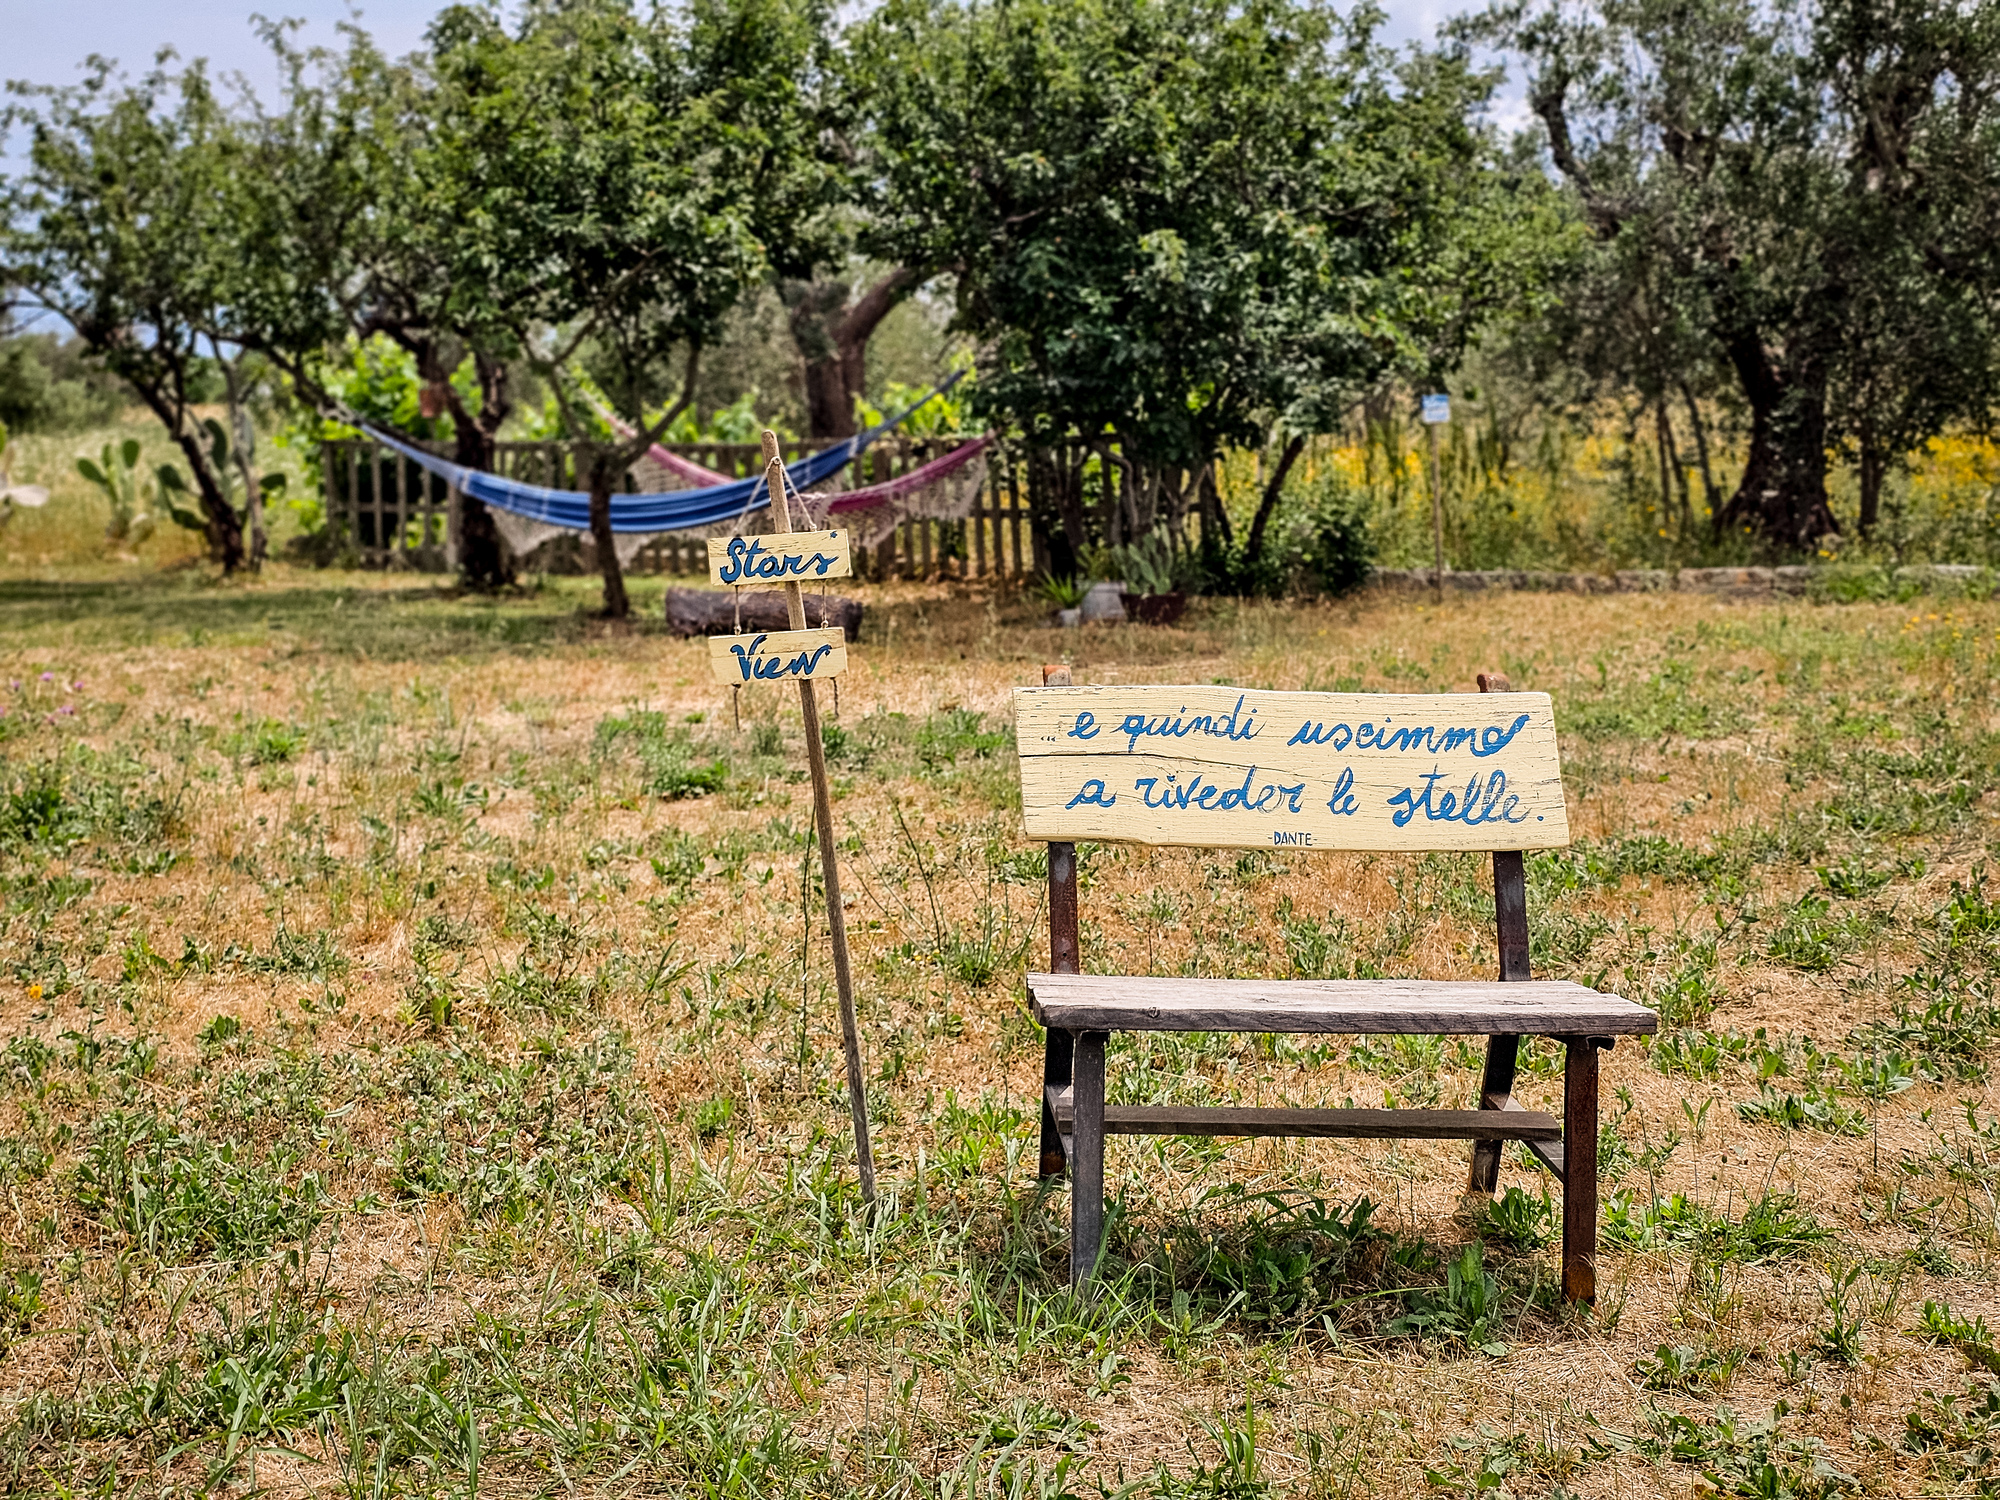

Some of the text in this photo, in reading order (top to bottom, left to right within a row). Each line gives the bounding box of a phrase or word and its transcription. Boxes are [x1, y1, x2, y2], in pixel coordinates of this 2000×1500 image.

[720, 537, 840, 584] Stars
[730, 634, 833, 681] View
[1110, 694, 1267, 753] quindi
[1287, 714, 1530, 757] uscimmo
[1065, 763, 1545, 827] a riveder le stelle.
